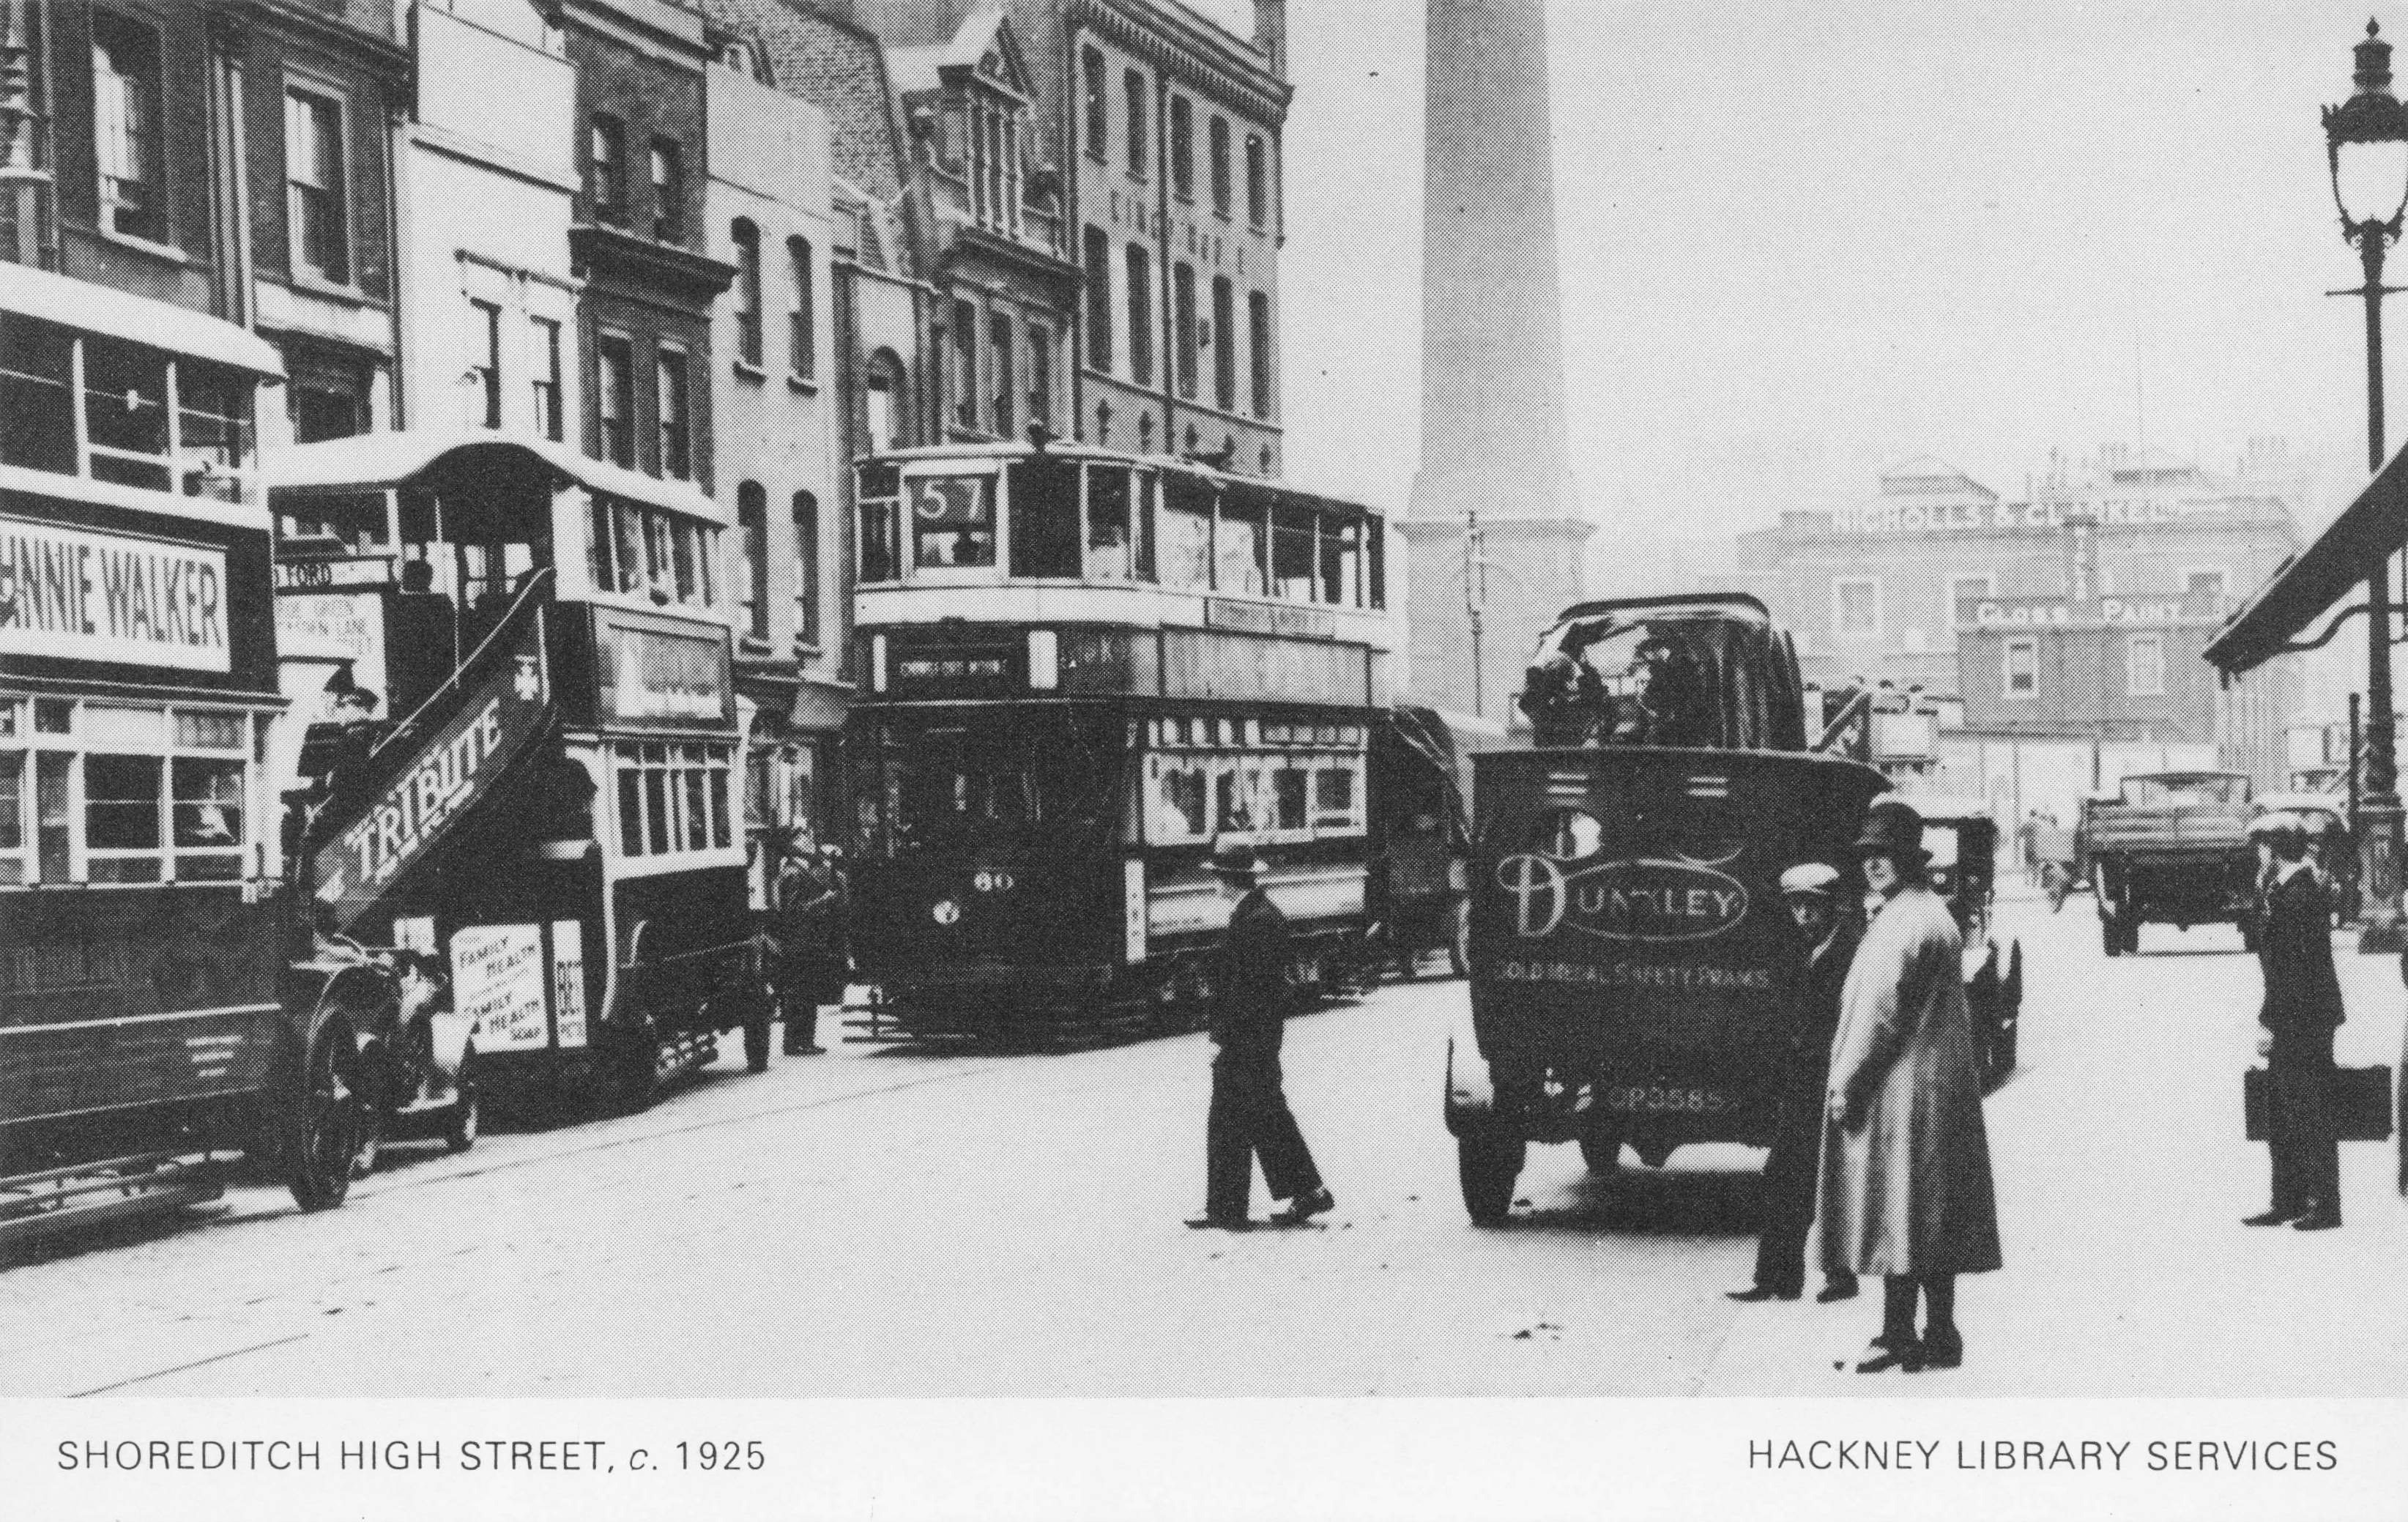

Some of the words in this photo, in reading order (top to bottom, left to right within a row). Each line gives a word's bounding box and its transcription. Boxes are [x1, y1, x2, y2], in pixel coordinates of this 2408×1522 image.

[917, 479, 982, 519] 57
[1831, 504, 1982, 532] NICHOLLS
[1994, 505, 2014, 527] &
[100, 547, 223, 648] WALKER
[2102, 598, 2182, 623] PAINT
[344, 697, 502, 884] TRIBUTE
[458, 935, 509, 970] FAMILY
[486, 943, 536, 979] HEALTH
[488, 998, 540, 1036] HEALTH
[509, 1025, 542, 1043] SOAP
